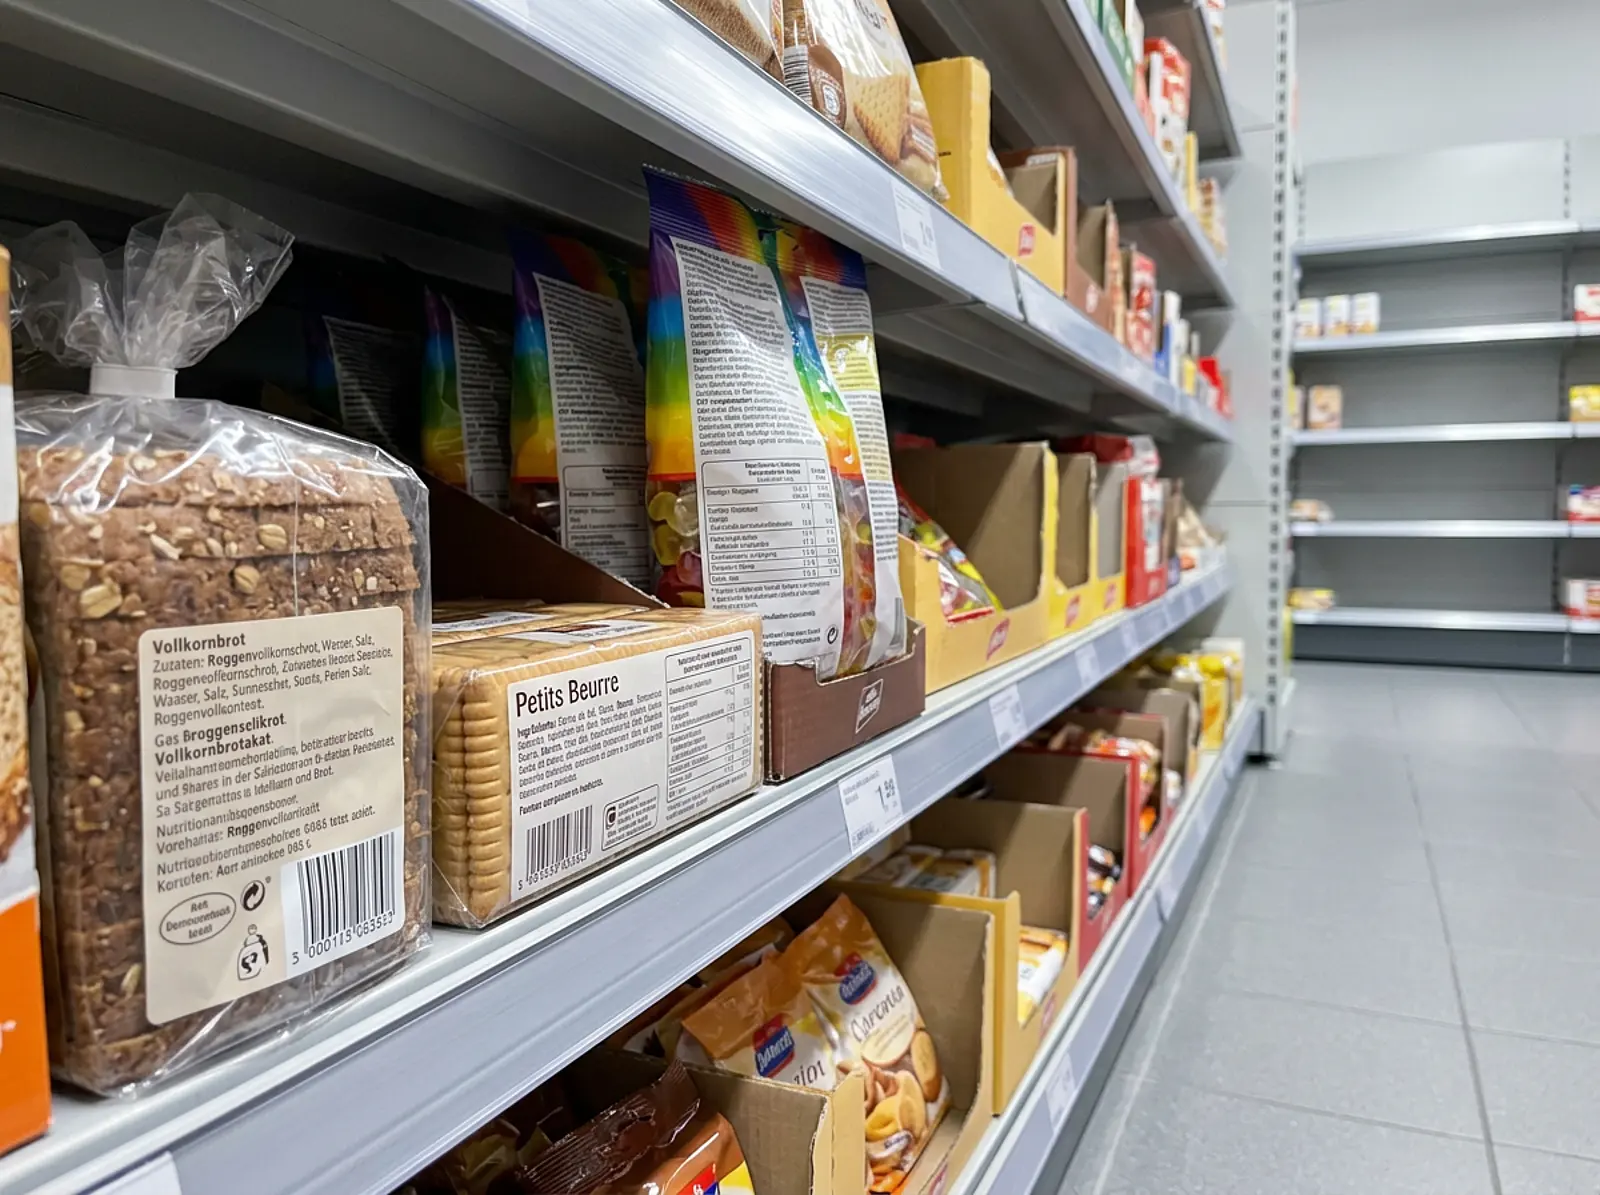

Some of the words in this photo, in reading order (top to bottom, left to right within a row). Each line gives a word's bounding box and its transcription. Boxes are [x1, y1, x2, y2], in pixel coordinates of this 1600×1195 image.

[152, 633, 246, 654] Vollkornbrot
[516, 687, 564, 717] Petits
[568, 675, 619, 704] Beurre
[156, 785, 180, 801] und
[222, 775, 232, 786] in
[235, 769, 251, 784] der
